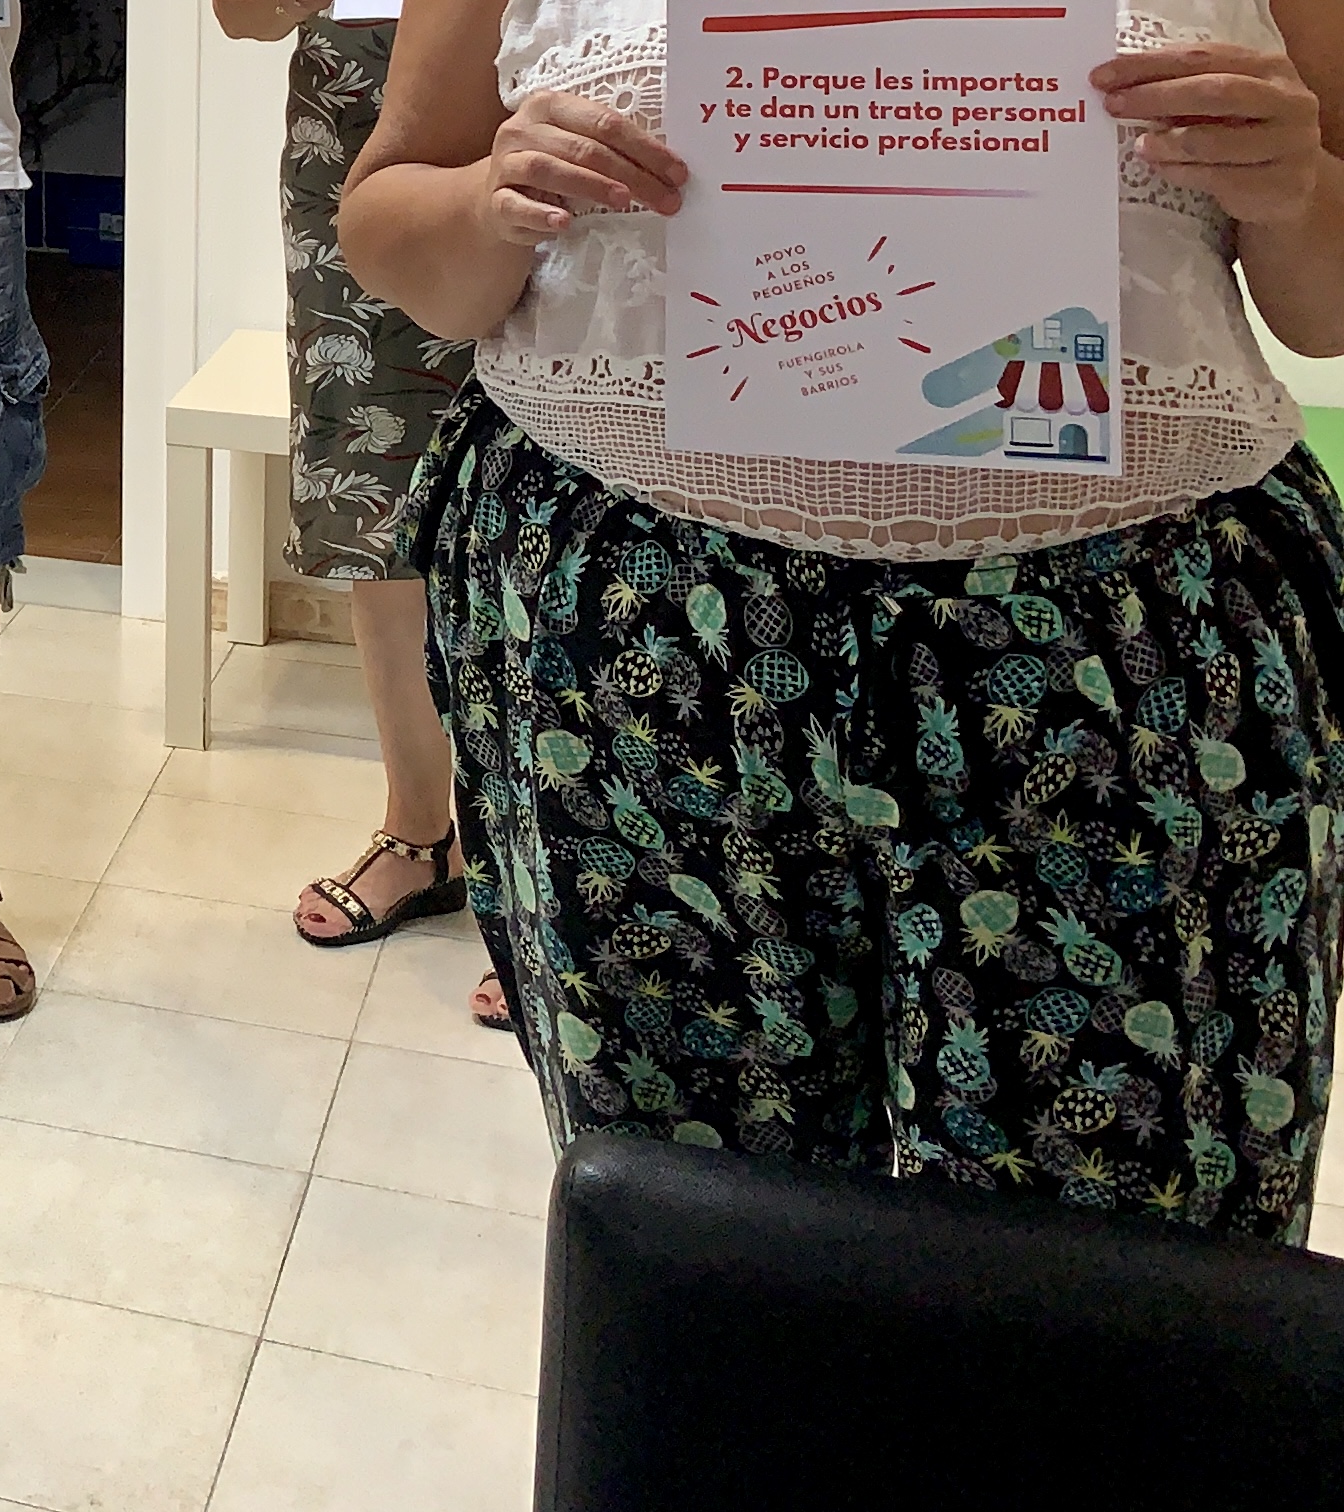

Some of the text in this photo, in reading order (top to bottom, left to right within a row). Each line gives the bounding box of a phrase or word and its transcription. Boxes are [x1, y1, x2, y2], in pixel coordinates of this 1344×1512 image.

[725, 66, 1059, 98] 2. Porque les importas
[699, 95, 1086, 127] y te dan un trato personal
[733, 126, 1049, 156] y servicio profesional
[726, 291, 883, 348] Negocios
